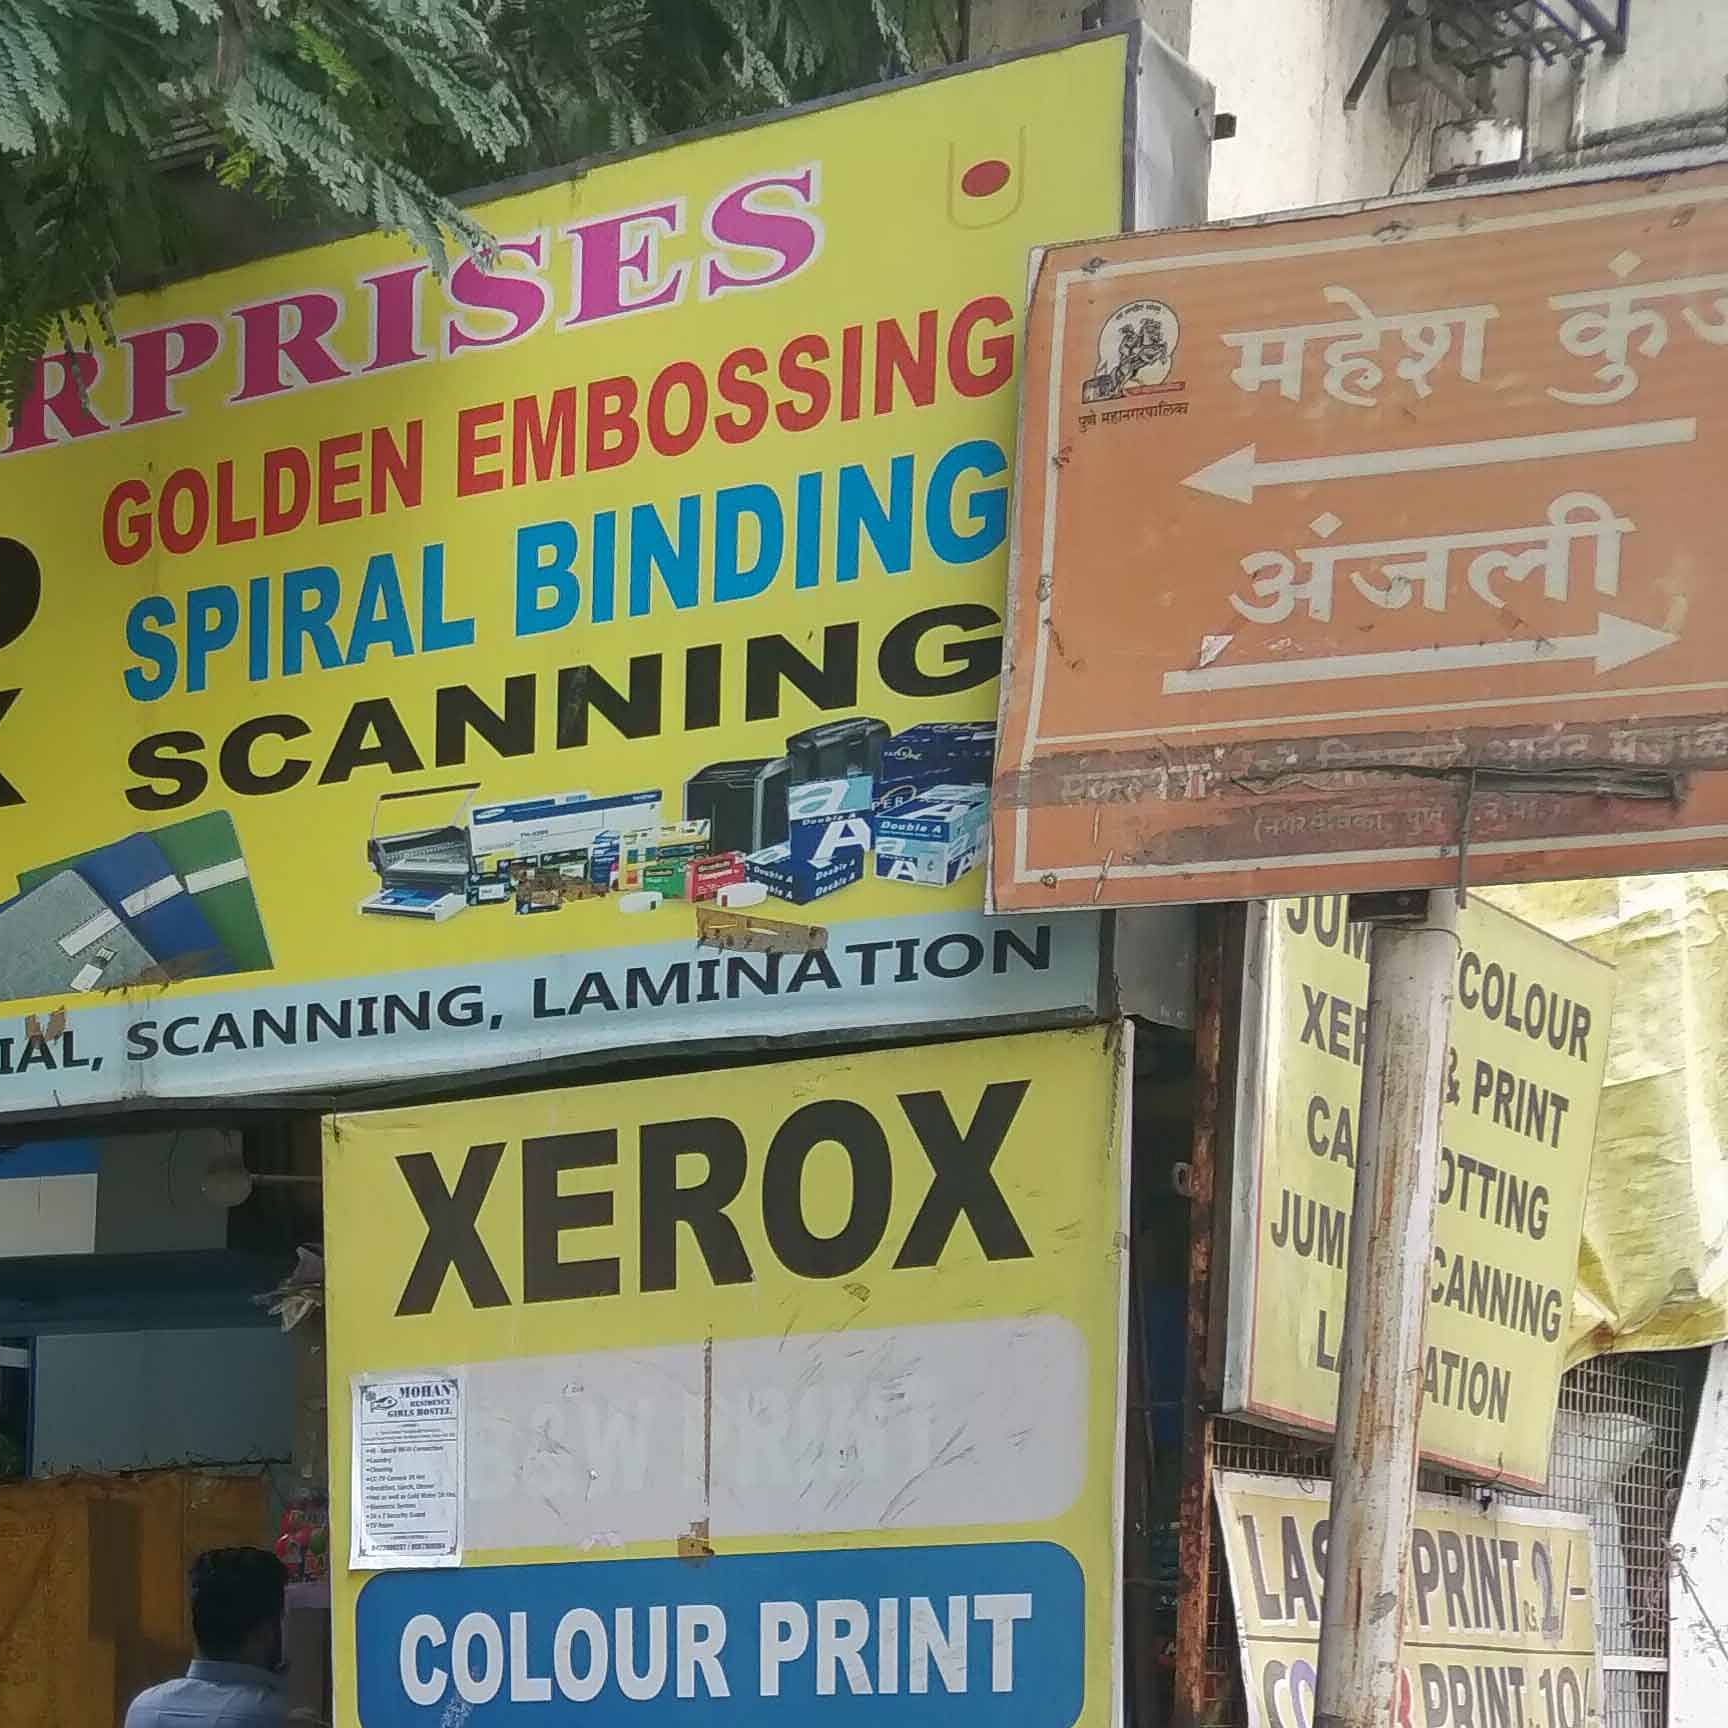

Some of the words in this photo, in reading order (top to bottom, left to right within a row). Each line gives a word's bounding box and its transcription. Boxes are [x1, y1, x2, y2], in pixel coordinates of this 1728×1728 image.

[1222, 284, 1501, 407] महेश
[103, 419, 424, 566] GOLDEN
[457, 295, 1015, 498] EMBOSSING
[123, 543, 475, 703] SPIRAL
[515, 438, 1008, 637] BINDING
[1229, 492, 1639, 625] अंजली
[124, 603, 1002, 811] SCANNING
[126, 984, 502, 1061] SCANNING,
[532, 925, 1051, 1017] LAMINATION
[1458, 951, 1591, 1062] COLOUR
[1472, 1058, 1569, 1149] PRINT
[393, 1079, 1035, 1317] XEROX
[1429, 1245, 1563, 1343] CANNING
[387, 1409, 415, 1417] GIRLS
[417, 1407, 452, 1416] HOSTEL
[399, 1384, 451, 1398] MOHAN
[1412, 1529, 1521, 1633] PRINT
[399, 1603, 731, 1708] COLOUR
[759, 1593, 1034, 1699] PRINT
